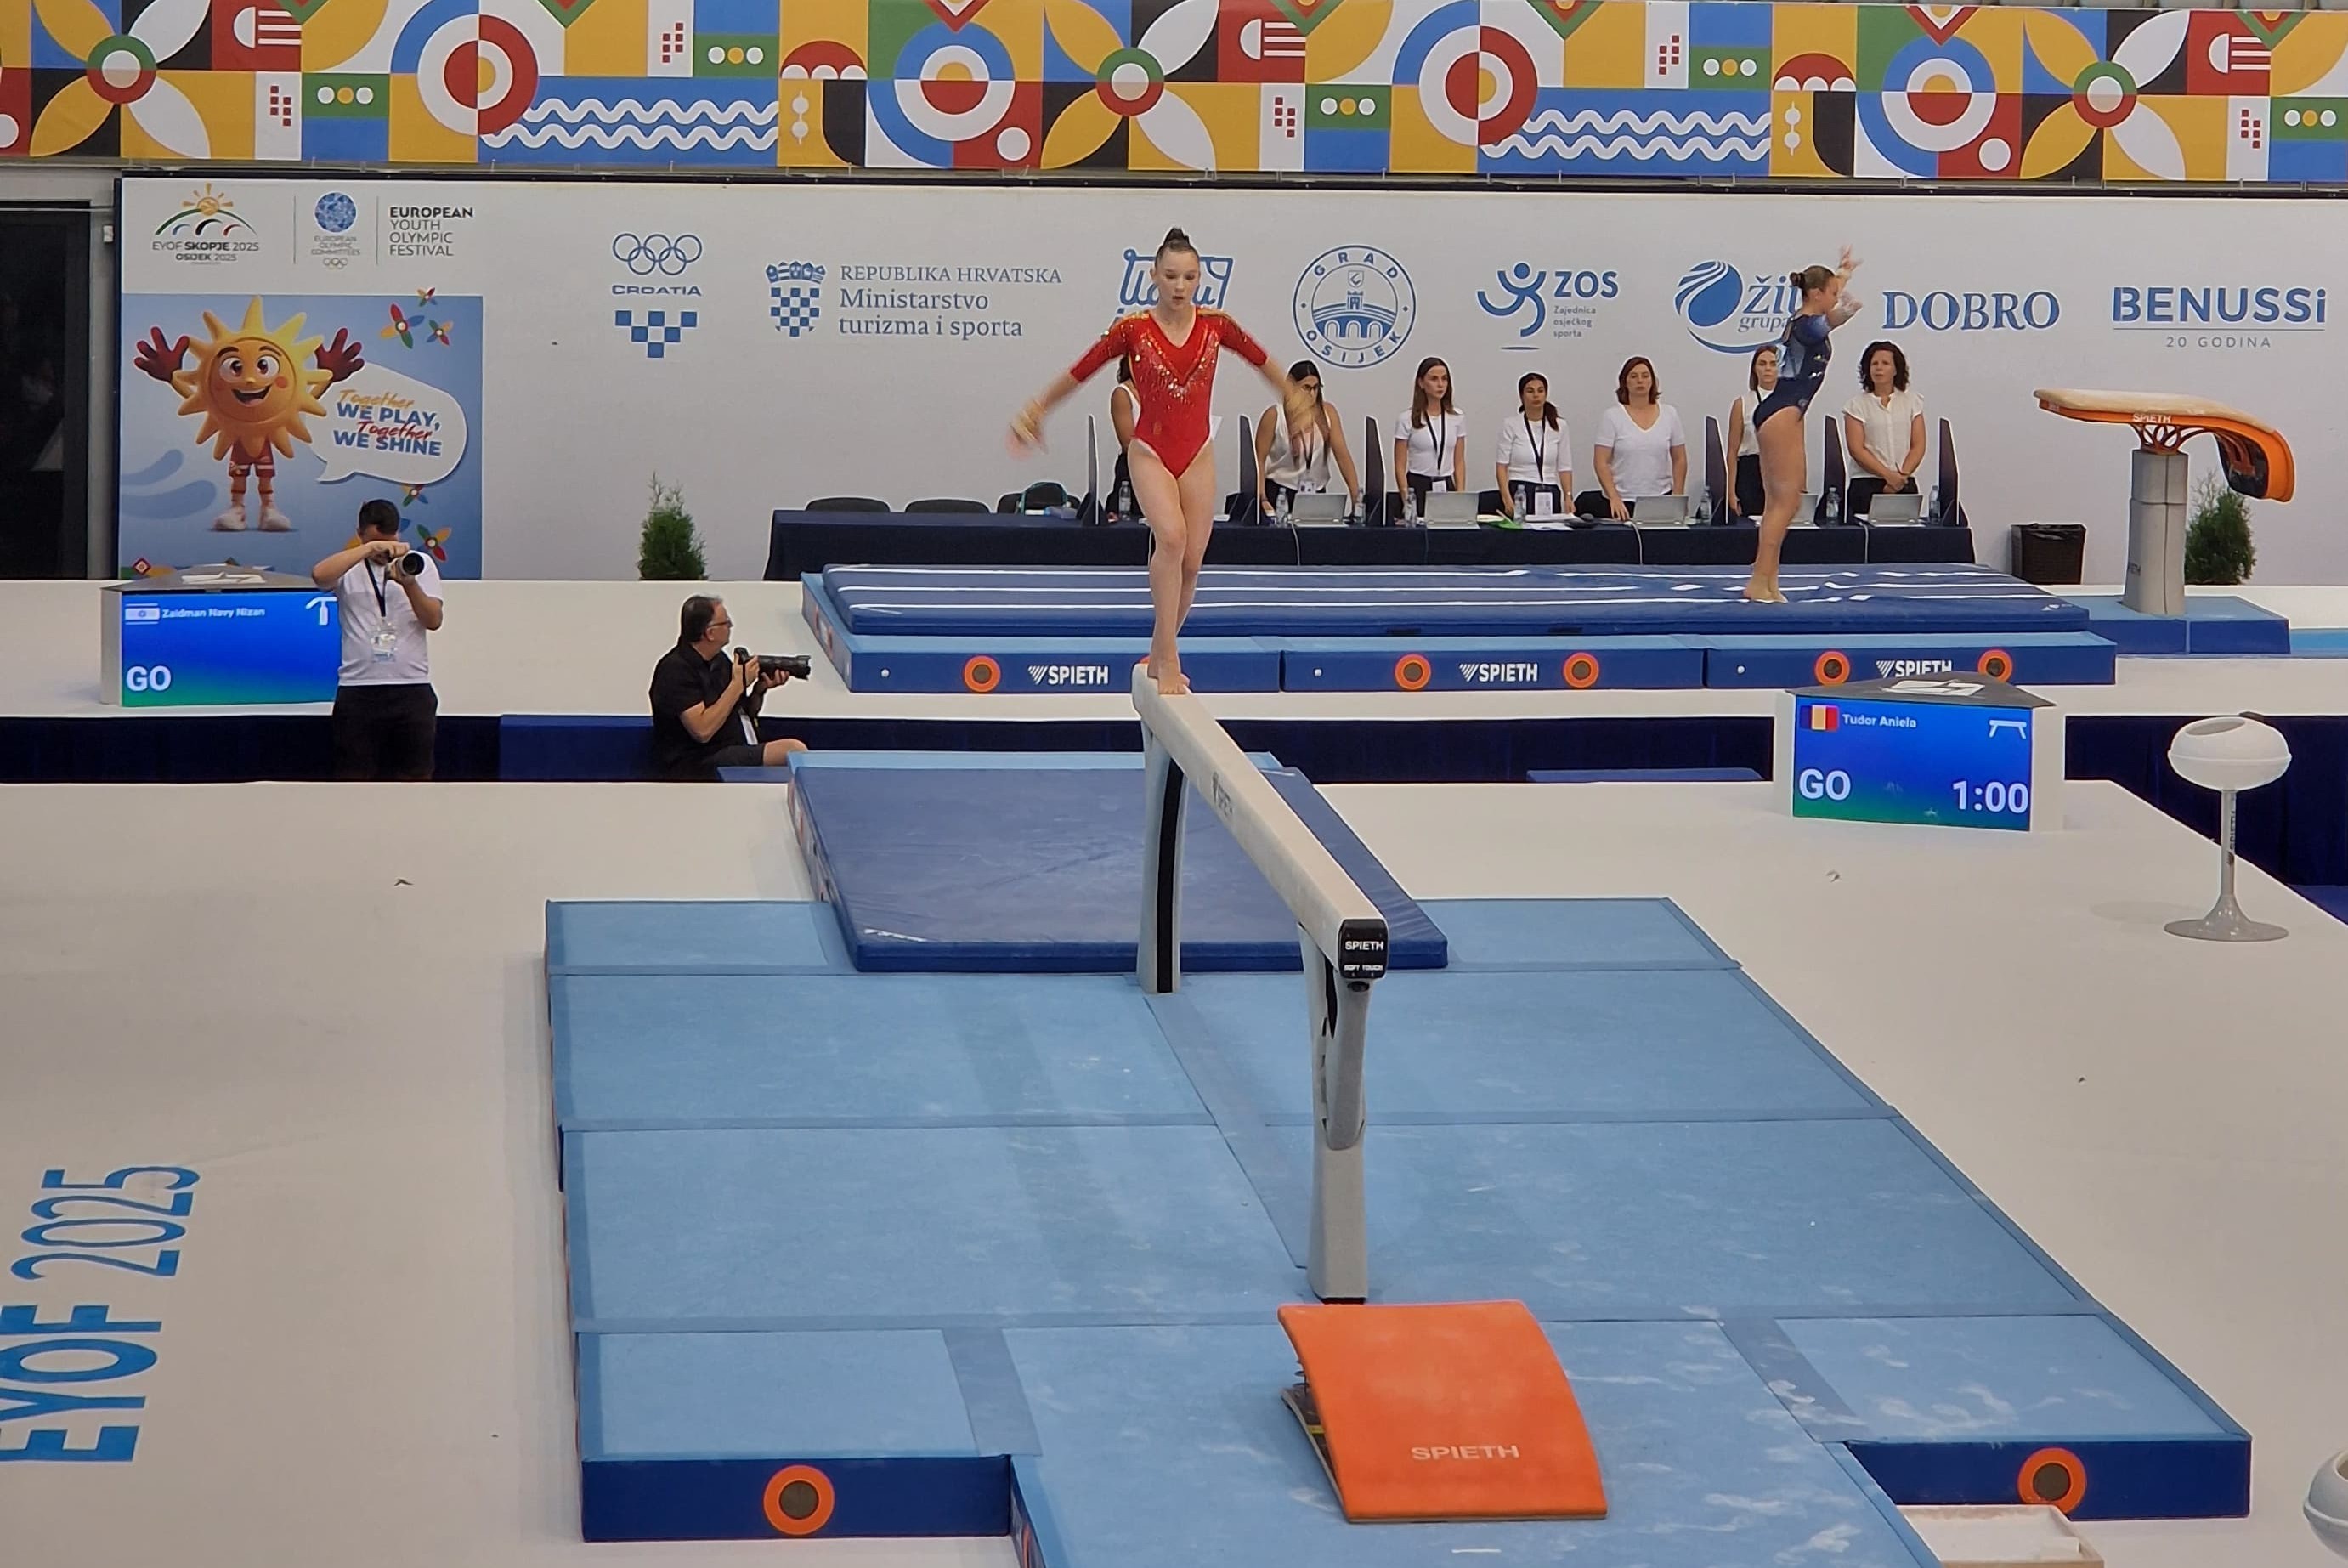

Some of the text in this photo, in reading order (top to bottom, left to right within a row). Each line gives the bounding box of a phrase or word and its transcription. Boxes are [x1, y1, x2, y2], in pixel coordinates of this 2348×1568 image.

[390, 207, 473, 218] EUROPEAN
[390, 220, 440, 230] YOUTH
[152, 241, 259, 252] EYOF SKOPJE 2025
[390, 232, 453, 243] OLYMPIC
[390, 245, 454, 256] FESTIVAL
[840, 266, 1062, 283] REPUBLIKA HRVATSKA
[1314, 252, 1399, 279] GRAD
[612, 285, 702, 297] CROATIA
[1553, 270, 1619, 298] ZOS
[840, 288, 988, 309] Ministarstvo
[1553, 306, 1597, 315] Zajednica
[1881, 291, 2061, 331] DOBRO
[840, 314, 1022, 340] turizma i sporta
[1553, 329, 1583, 339] sporta
[1306, 331, 1401, 363] OSIJEK
[2166, 337, 2272, 348] 20 GODINA
[340, 388, 415, 408] Together
[337, 402, 440, 431] WE PLAY,
[2132, 413, 2171, 423] SPIETH
[357, 421, 433, 440] Together
[333, 430, 442, 456] WE SHINE
[161, 608, 206, 619] Zaidman
[126, 665, 172, 691] GO
[1048, 665, 1109, 685] SPIETH
[1479, 663, 1538, 682] SPIETH
[1842, 713, 1917, 728] Tudor Aniela
[1799, 768, 2028, 813] GO 1:00
[1345, 941, 1384, 950] SPIETH
[0, 1166, 201, 1463] EYOF 2025
[1412, 1445, 1520, 1461] SPIETH
